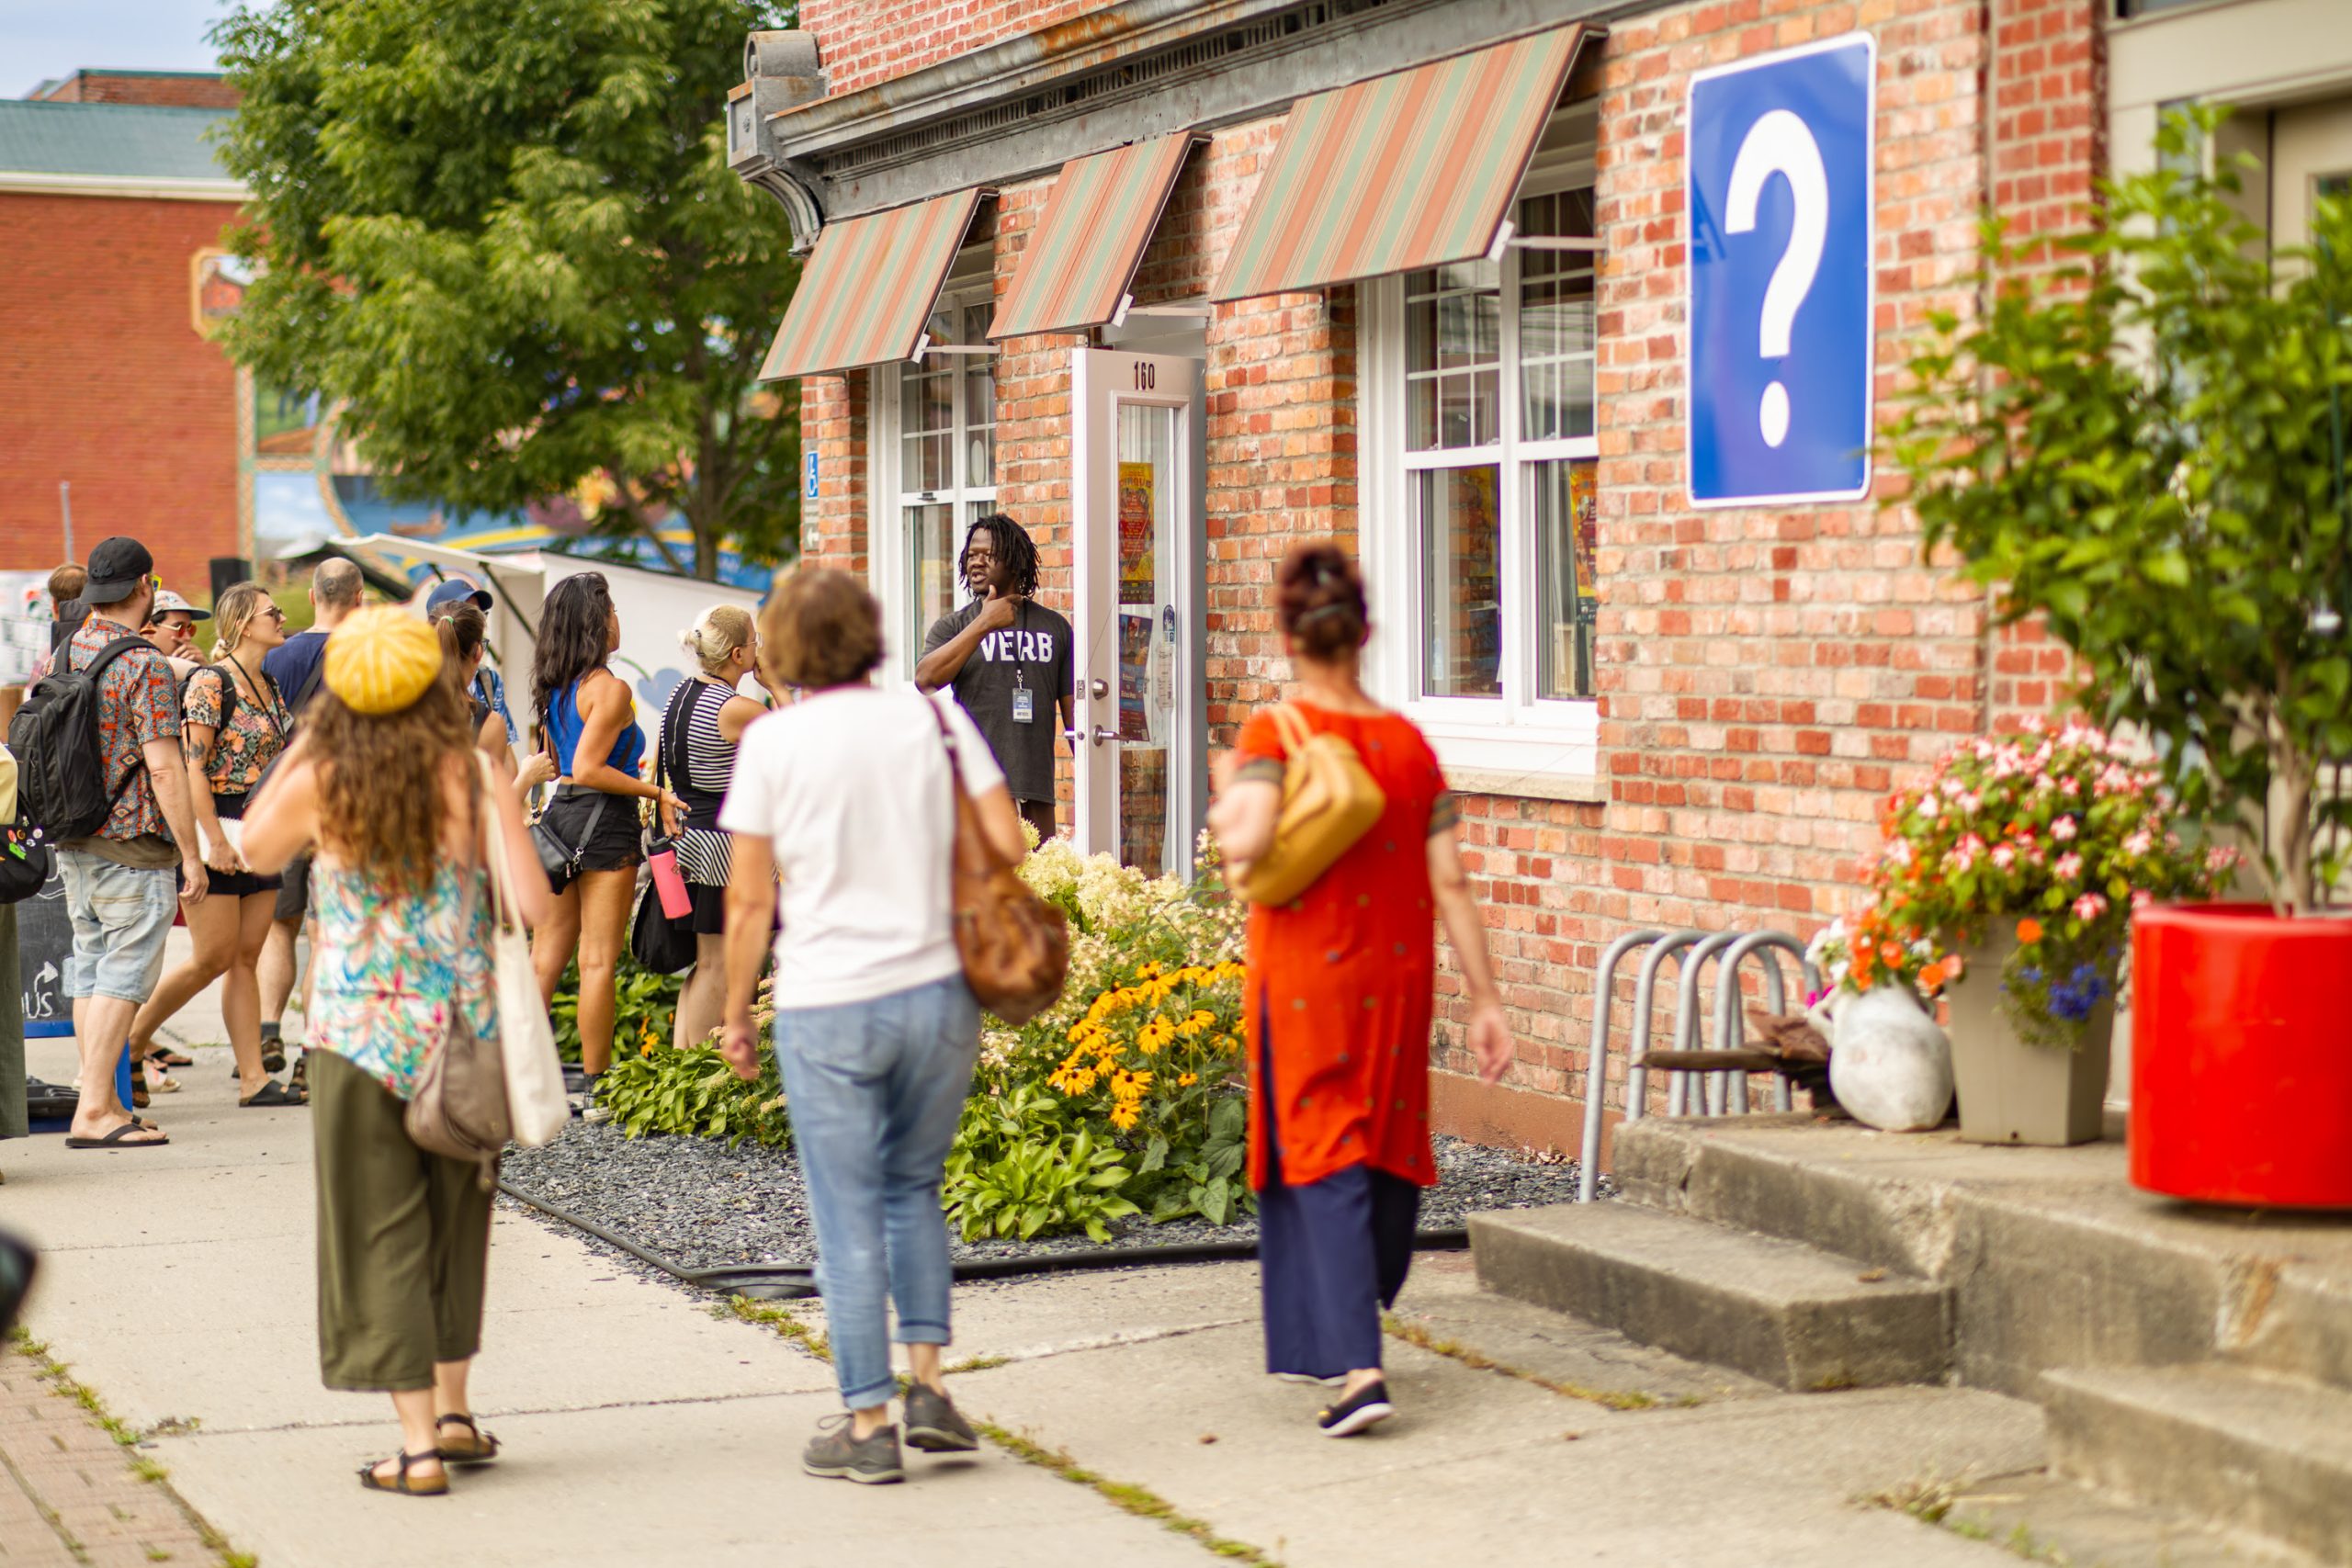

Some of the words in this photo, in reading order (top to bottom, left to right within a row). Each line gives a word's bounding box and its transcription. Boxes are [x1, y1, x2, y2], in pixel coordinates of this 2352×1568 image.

[1724, 108, 1829, 448] ?
[1134, 360, 1155, 390] 160
[979, 631, 1053, 663] VERB
